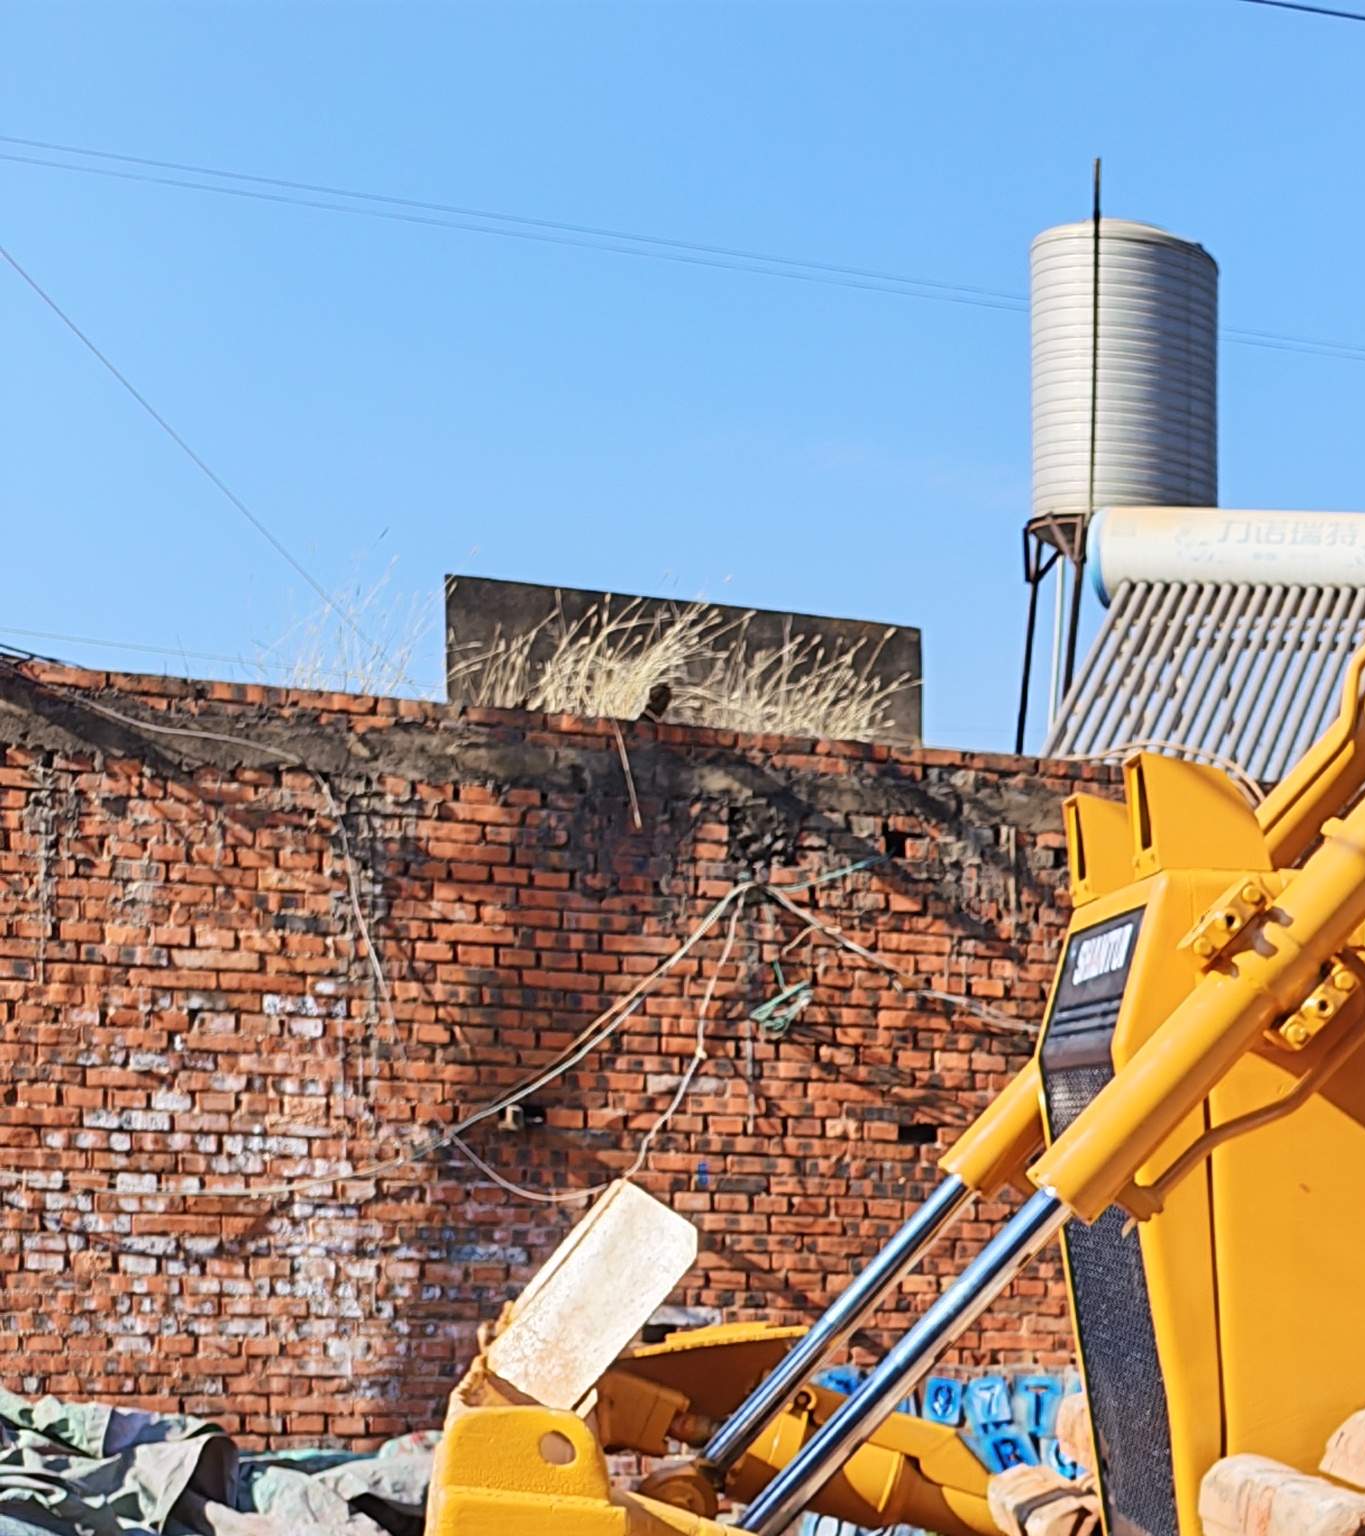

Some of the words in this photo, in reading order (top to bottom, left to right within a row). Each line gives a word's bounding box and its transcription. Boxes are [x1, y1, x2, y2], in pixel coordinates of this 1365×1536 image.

[1217, 519, 1360, 548] 力诺瑞特
[1024, 1385, 1051, 1427] T
